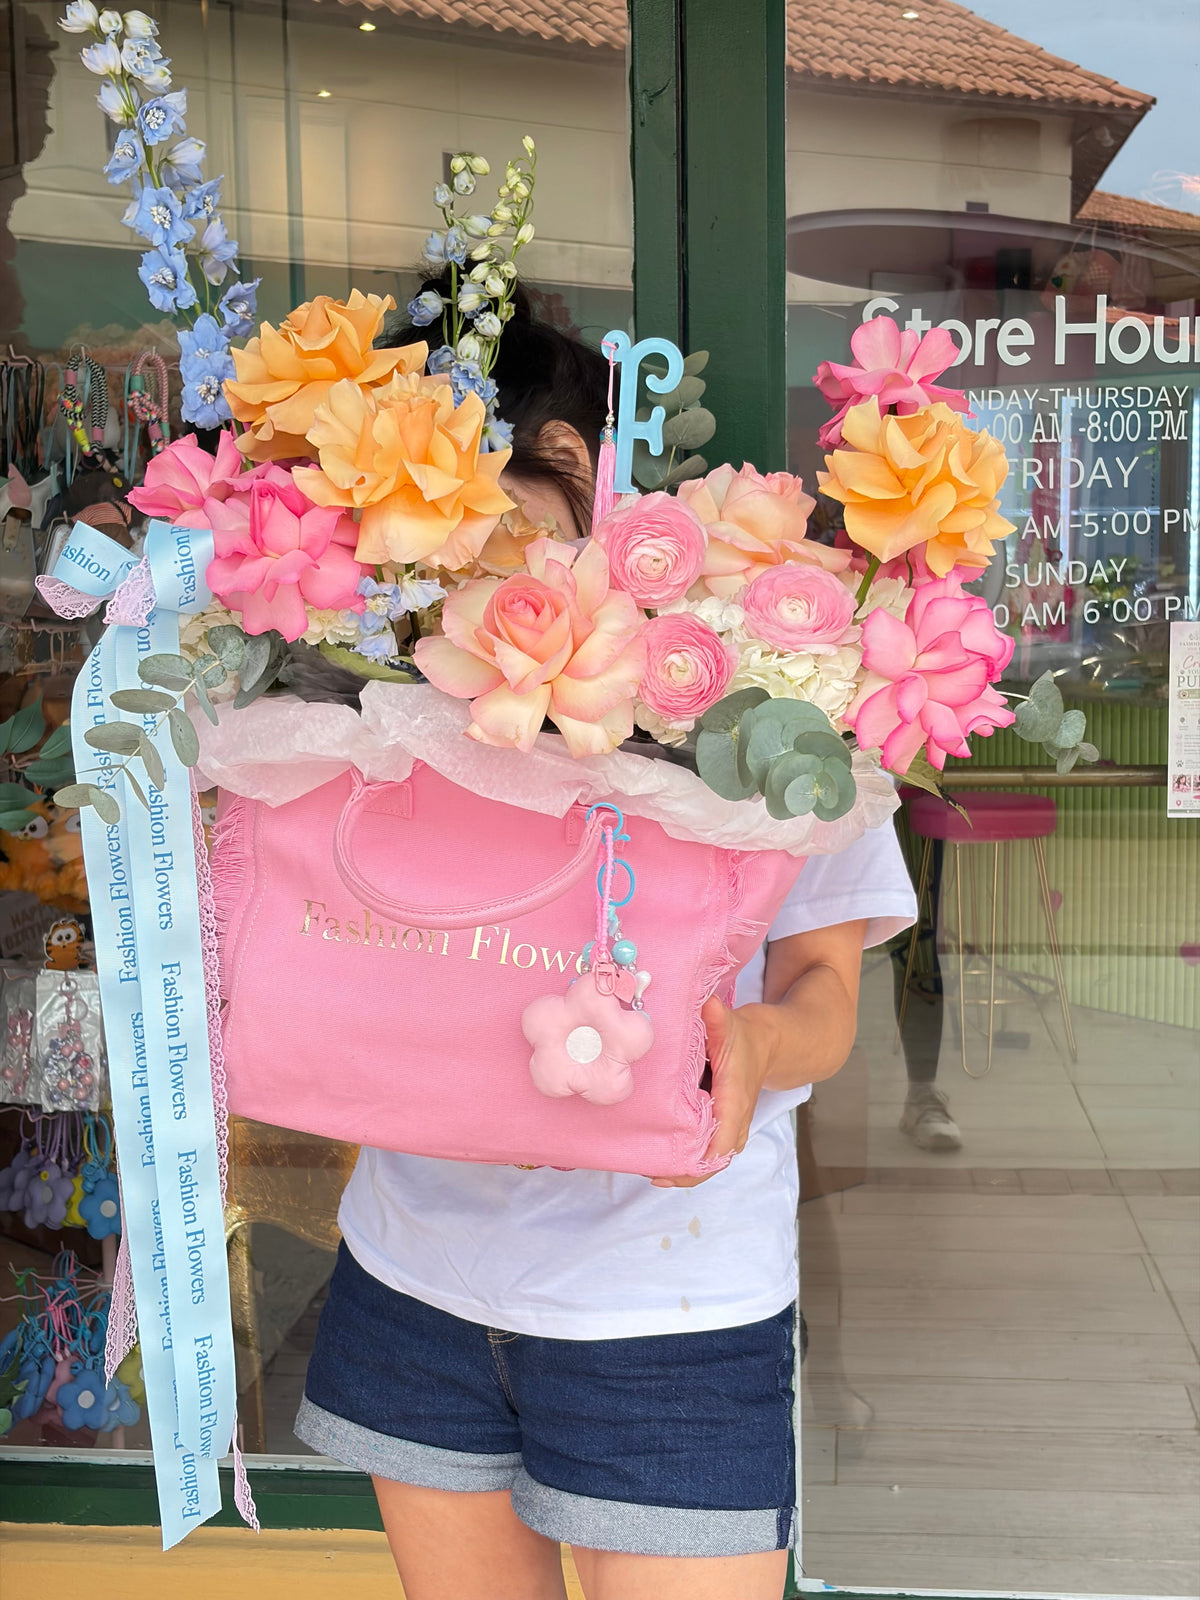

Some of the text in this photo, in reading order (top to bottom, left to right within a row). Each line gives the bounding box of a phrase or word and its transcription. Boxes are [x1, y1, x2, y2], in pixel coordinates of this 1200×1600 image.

[1055, 294, 1200, 365] Hou
[1029, 412, 1072, 443] AM
[1147, 410, 1188, 441] PM
[62, 544, 111, 582] ashion
[174, 534, 197, 608] Fashion
[1005, 558, 1128, 588] SUNDAY
[1021, 601, 1066, 627] AM
[149, 783, 174, 930] ashion Flowers
[106, 823, 139, 984] Fashion Flowers
[299, 899, 450, 957] Fashion
[130, 1012, 149, 1090] Flowers
[161, 961, 188, 1120] Fashion Flowers
[177, 1149, 206, 1305] Fashion Flowers
[194, 1333, 217, 1409] Fashion
[179, 1453, 201, 1520] Fashion
